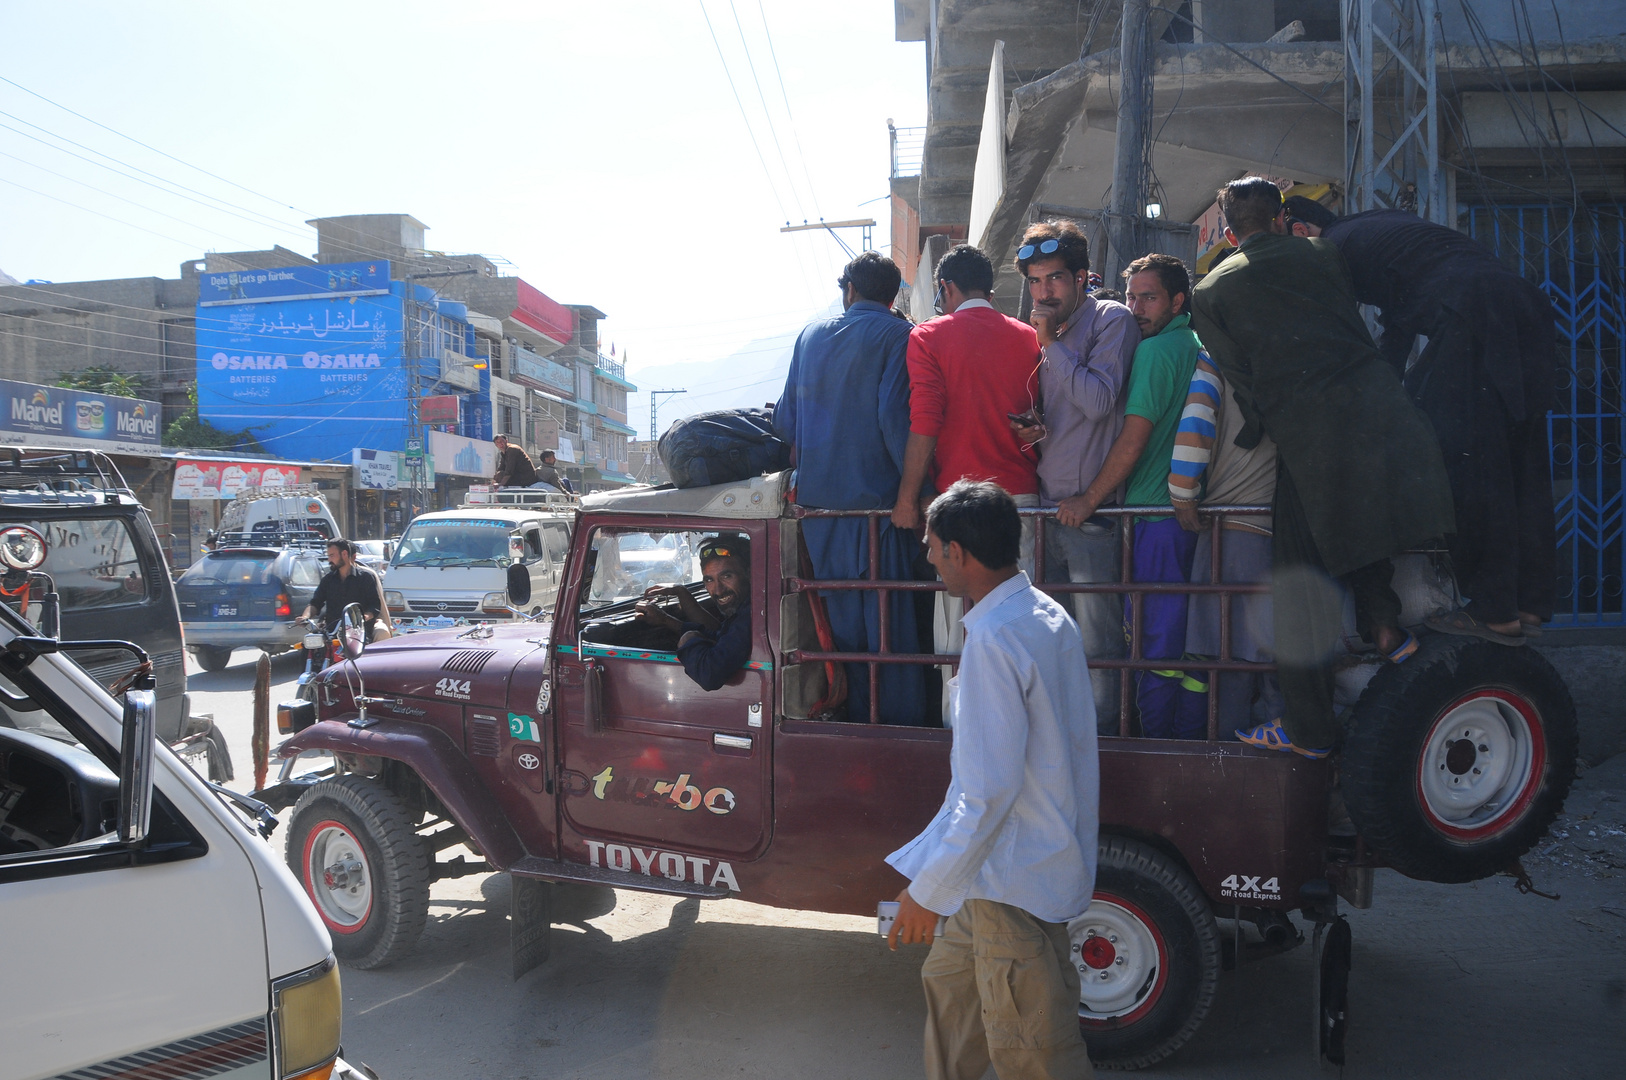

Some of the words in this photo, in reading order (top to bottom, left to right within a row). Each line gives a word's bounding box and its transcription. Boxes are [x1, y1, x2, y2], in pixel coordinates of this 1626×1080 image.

[211, 276, 228, 286] Delo
[238, 274, 256, 284] Let's
[257, 275, 267, 284] go
[211, 352, 289, 371] OSAKA
[302, 351, 382, 369] OSAKA
[230, 375, 278, 384] BATTERIES
[320, 373, 369, 382] BATTERIES
[11, 397, 63, 425] Marvel
[423, 407, 456, 417] AGFA
[116, 411, 157, 434] Marvel
[435, 678, 471, 694] 4X4
[442, 690, 453, 698] Road
[453, 691, 471, 700] Express
[583, 839, 741, 893] TOYOTA
[1221, 874, 1280, 893] 4X4
[1221, 889, 1232, 897] Off
[1253, 891, 1281, 900] Express
